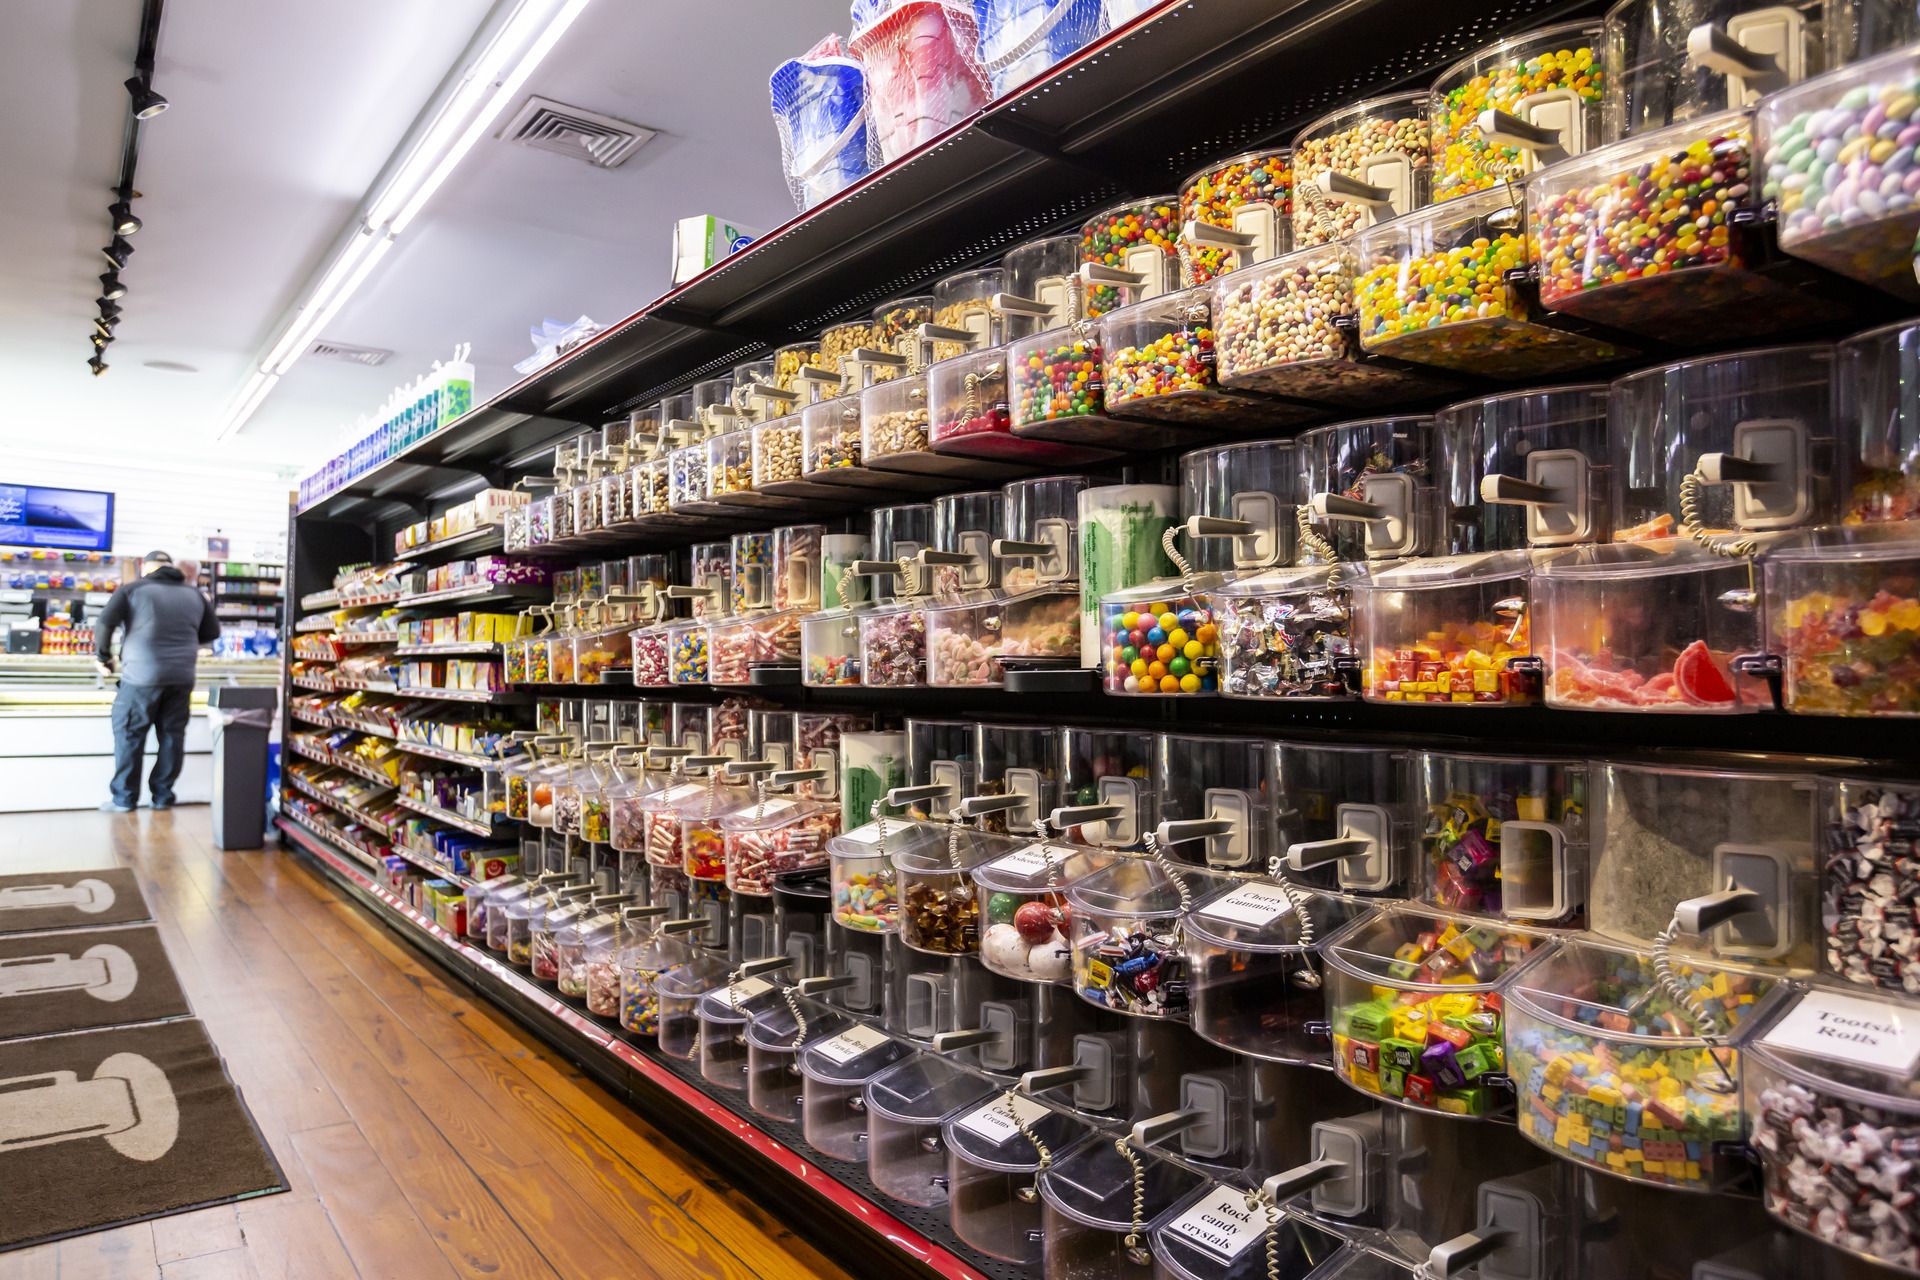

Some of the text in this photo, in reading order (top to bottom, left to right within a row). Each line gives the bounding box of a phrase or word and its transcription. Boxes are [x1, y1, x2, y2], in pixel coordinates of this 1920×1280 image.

[1226, 897, 1278, 913] Gummies
[1243, 892, 1283, 905] Cherry
[1817, 1025, 1879, 1046] Rolls
[828, 1041, 855, 1056] Crawler
[982, 1113, 1012, 1129] Creams
[1217, 1202, 1253, 1224] Rock
[1201, 1213, 1242, 1236] candy
[1182, 1222, 1232, 1250] crystals
